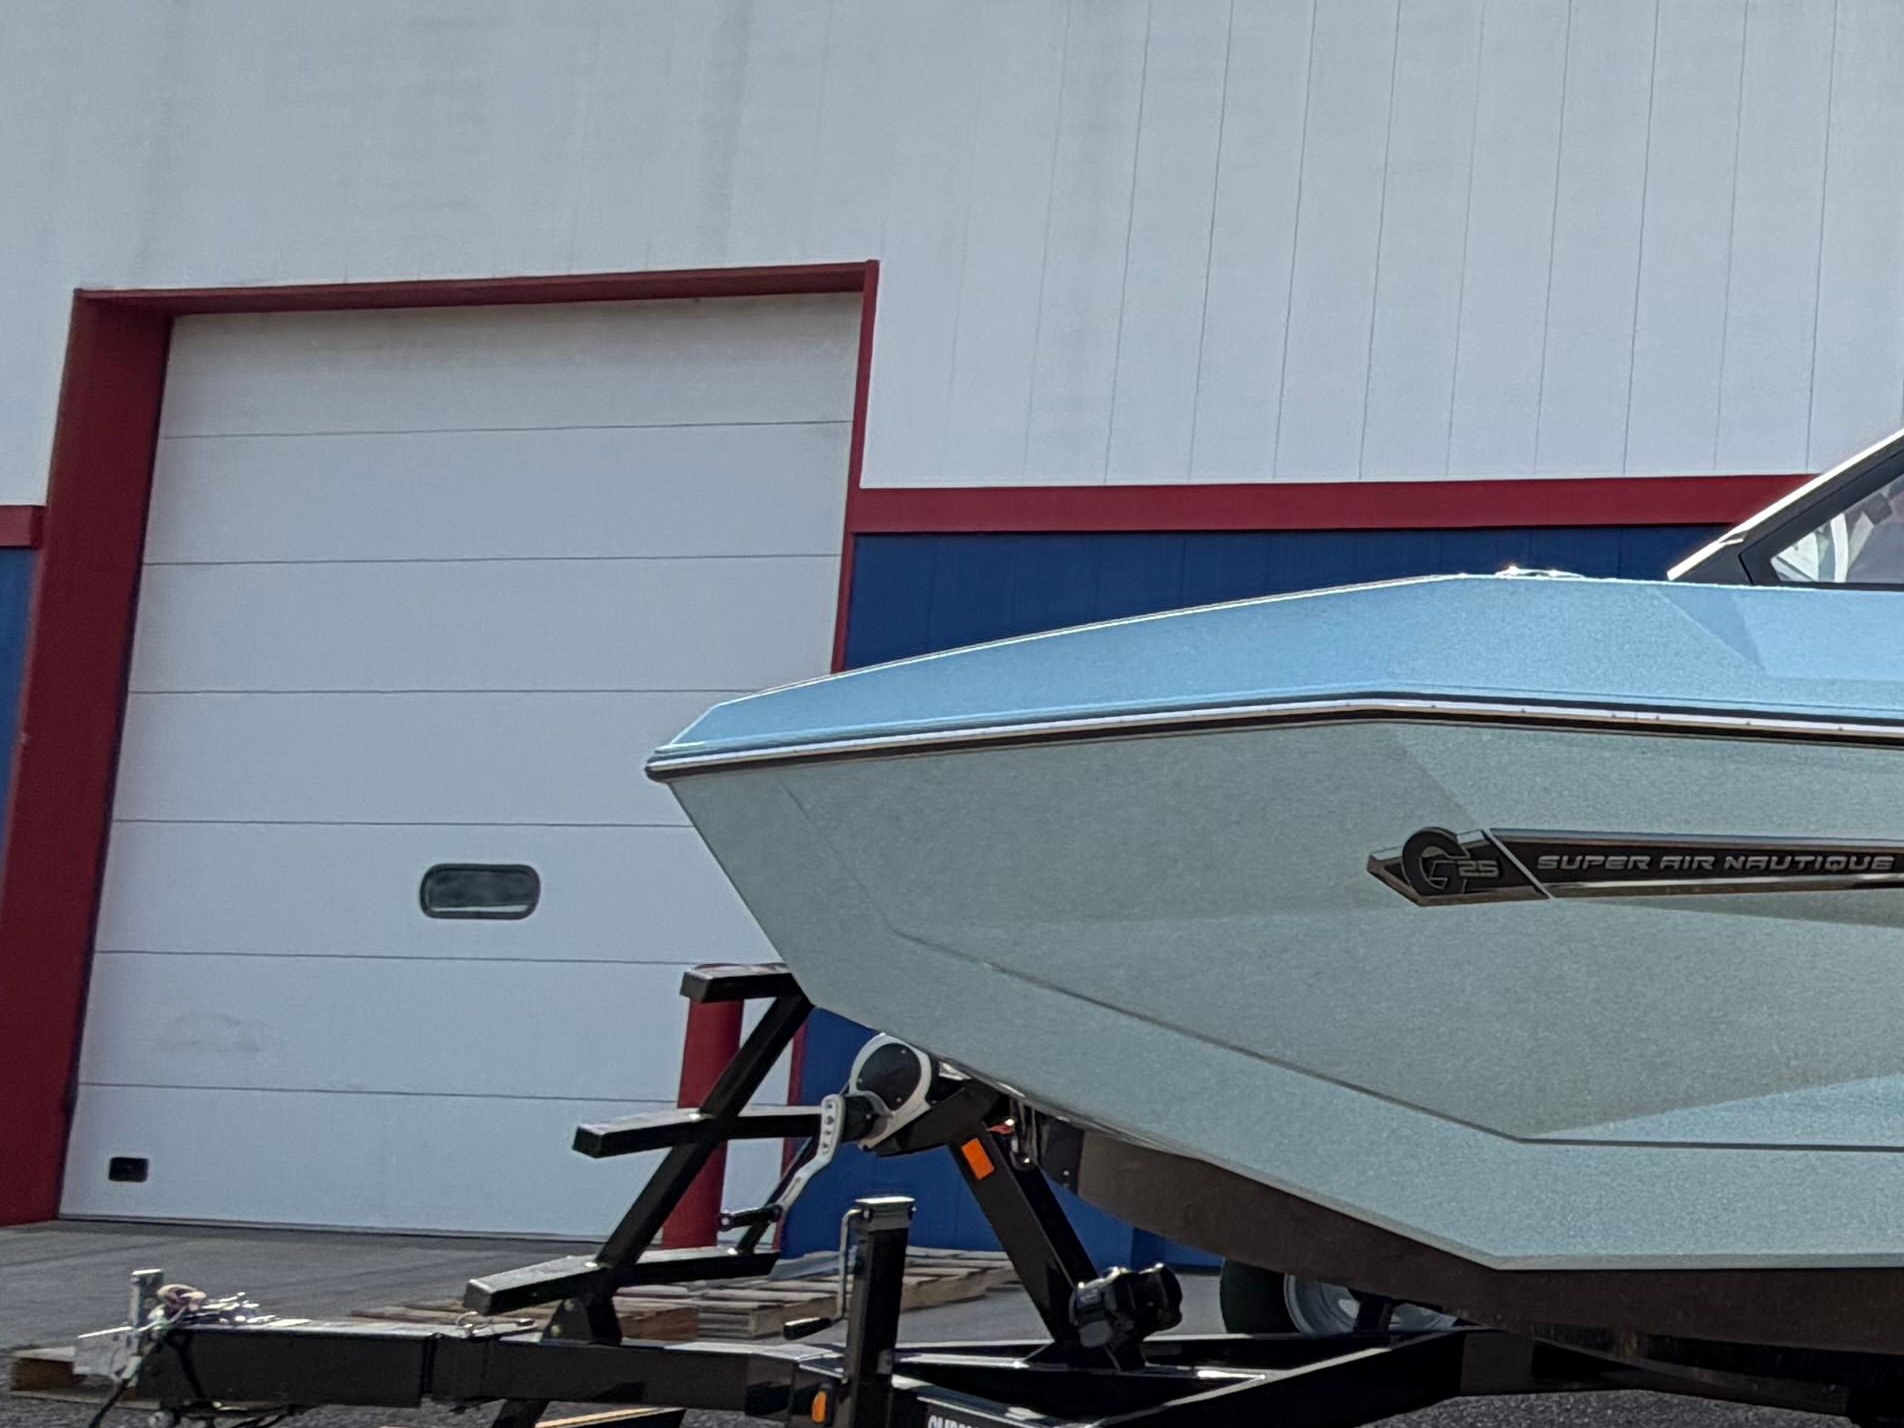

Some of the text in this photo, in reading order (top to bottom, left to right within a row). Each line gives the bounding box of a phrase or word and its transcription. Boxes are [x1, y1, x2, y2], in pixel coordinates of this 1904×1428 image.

[1537, 855, 1650, 870] SUPER
[1659, 855, 1715, 870] AIR
[1724, 855, 1896, 872] NAUTIQUE
